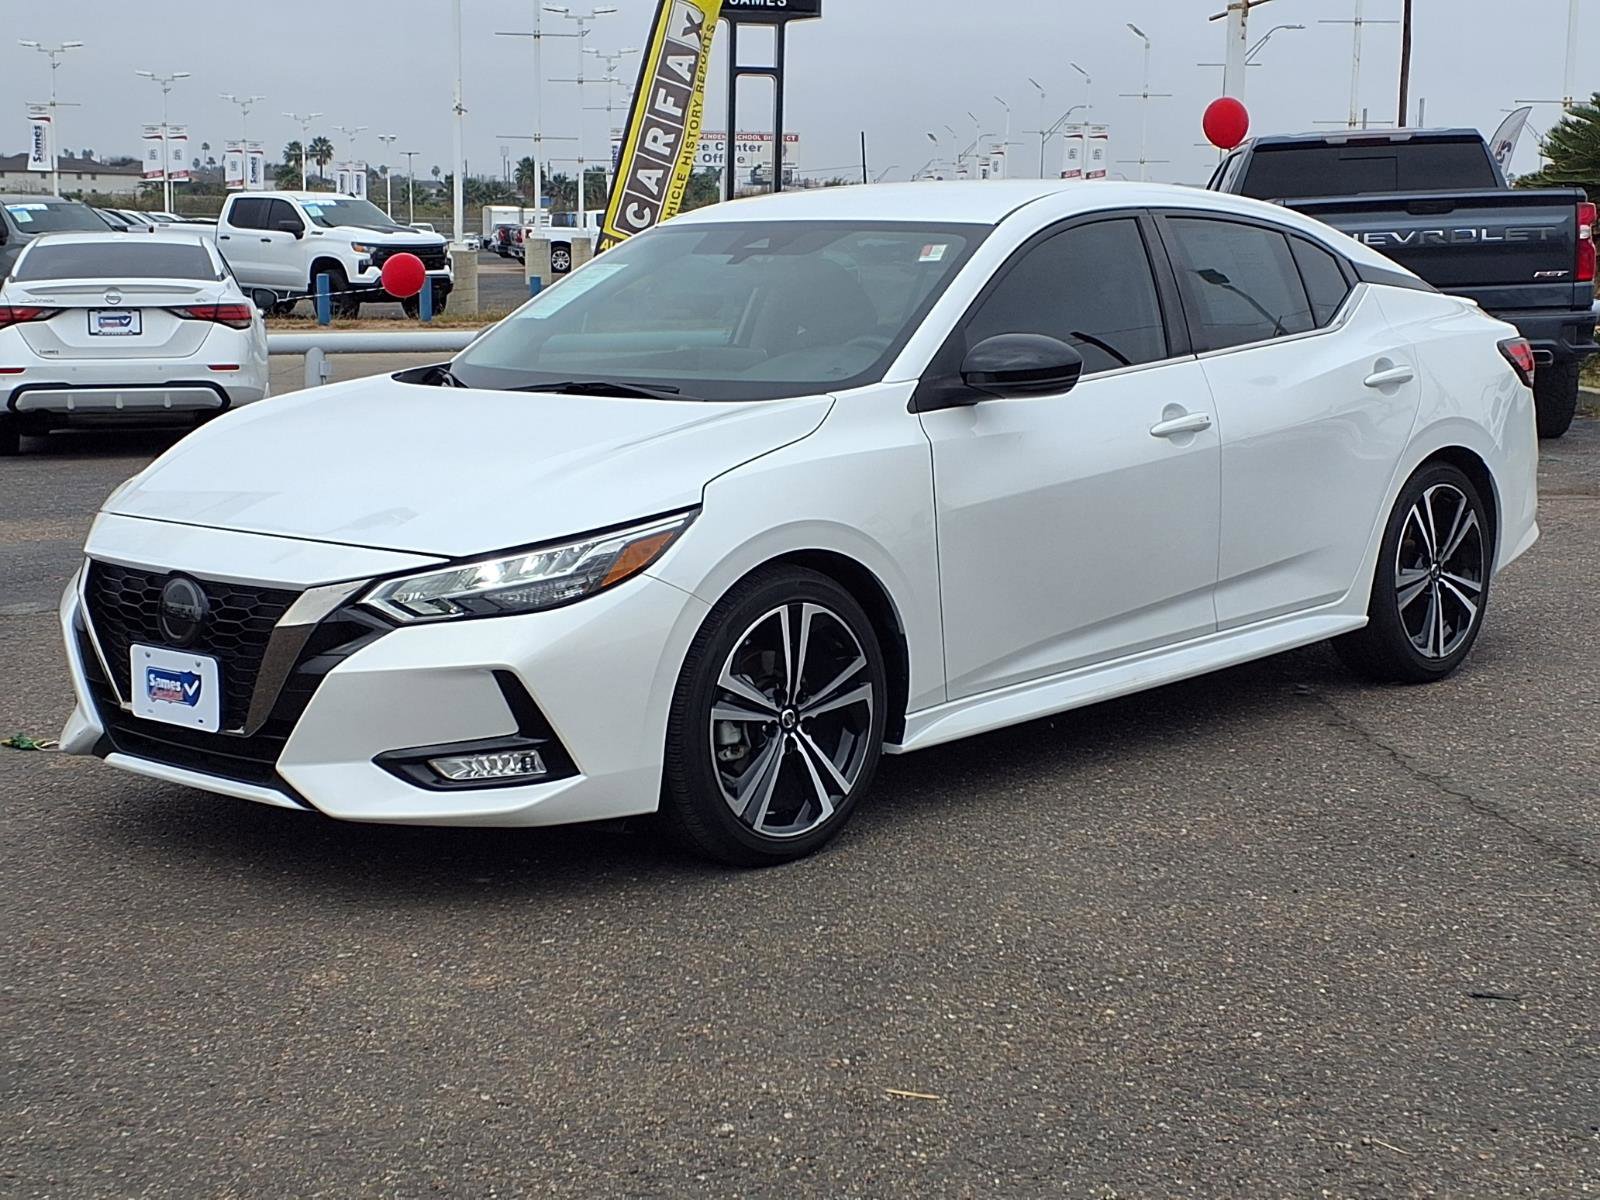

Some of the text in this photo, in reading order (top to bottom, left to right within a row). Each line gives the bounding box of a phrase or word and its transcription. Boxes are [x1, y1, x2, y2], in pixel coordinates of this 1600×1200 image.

[625, 10, 704, 229] CARFAX
[715, 142, 763, 152] Cnter
[665, 172, 687, 221] HICLE
[681, 100, 702, 166] HISTORY
[702, 153, 745, 164] Offe
[149, 673, 182, 692] Sames
